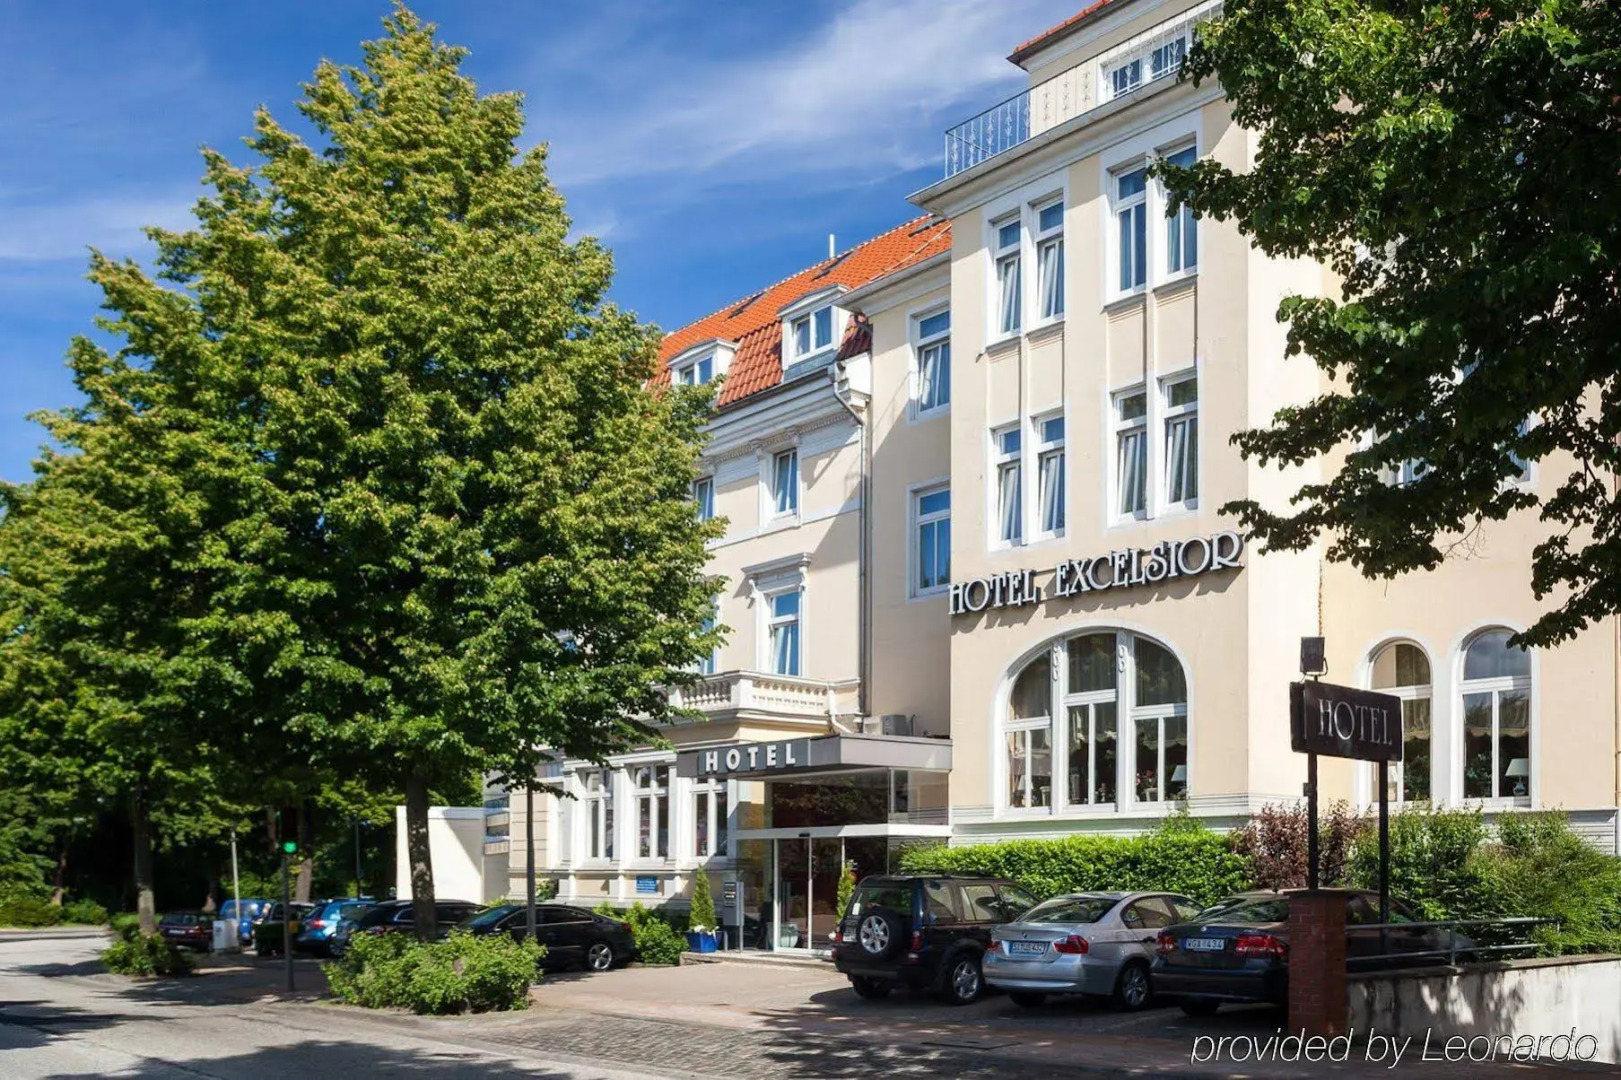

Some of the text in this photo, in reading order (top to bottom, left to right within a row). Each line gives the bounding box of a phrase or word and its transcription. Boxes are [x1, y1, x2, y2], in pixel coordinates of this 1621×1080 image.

[948, 530, 1246, 615] HOTEL EXCELSIOR
[1318, 698, 1393, 746] HOTEL
[705, 743, 796, 771] HOTEL
